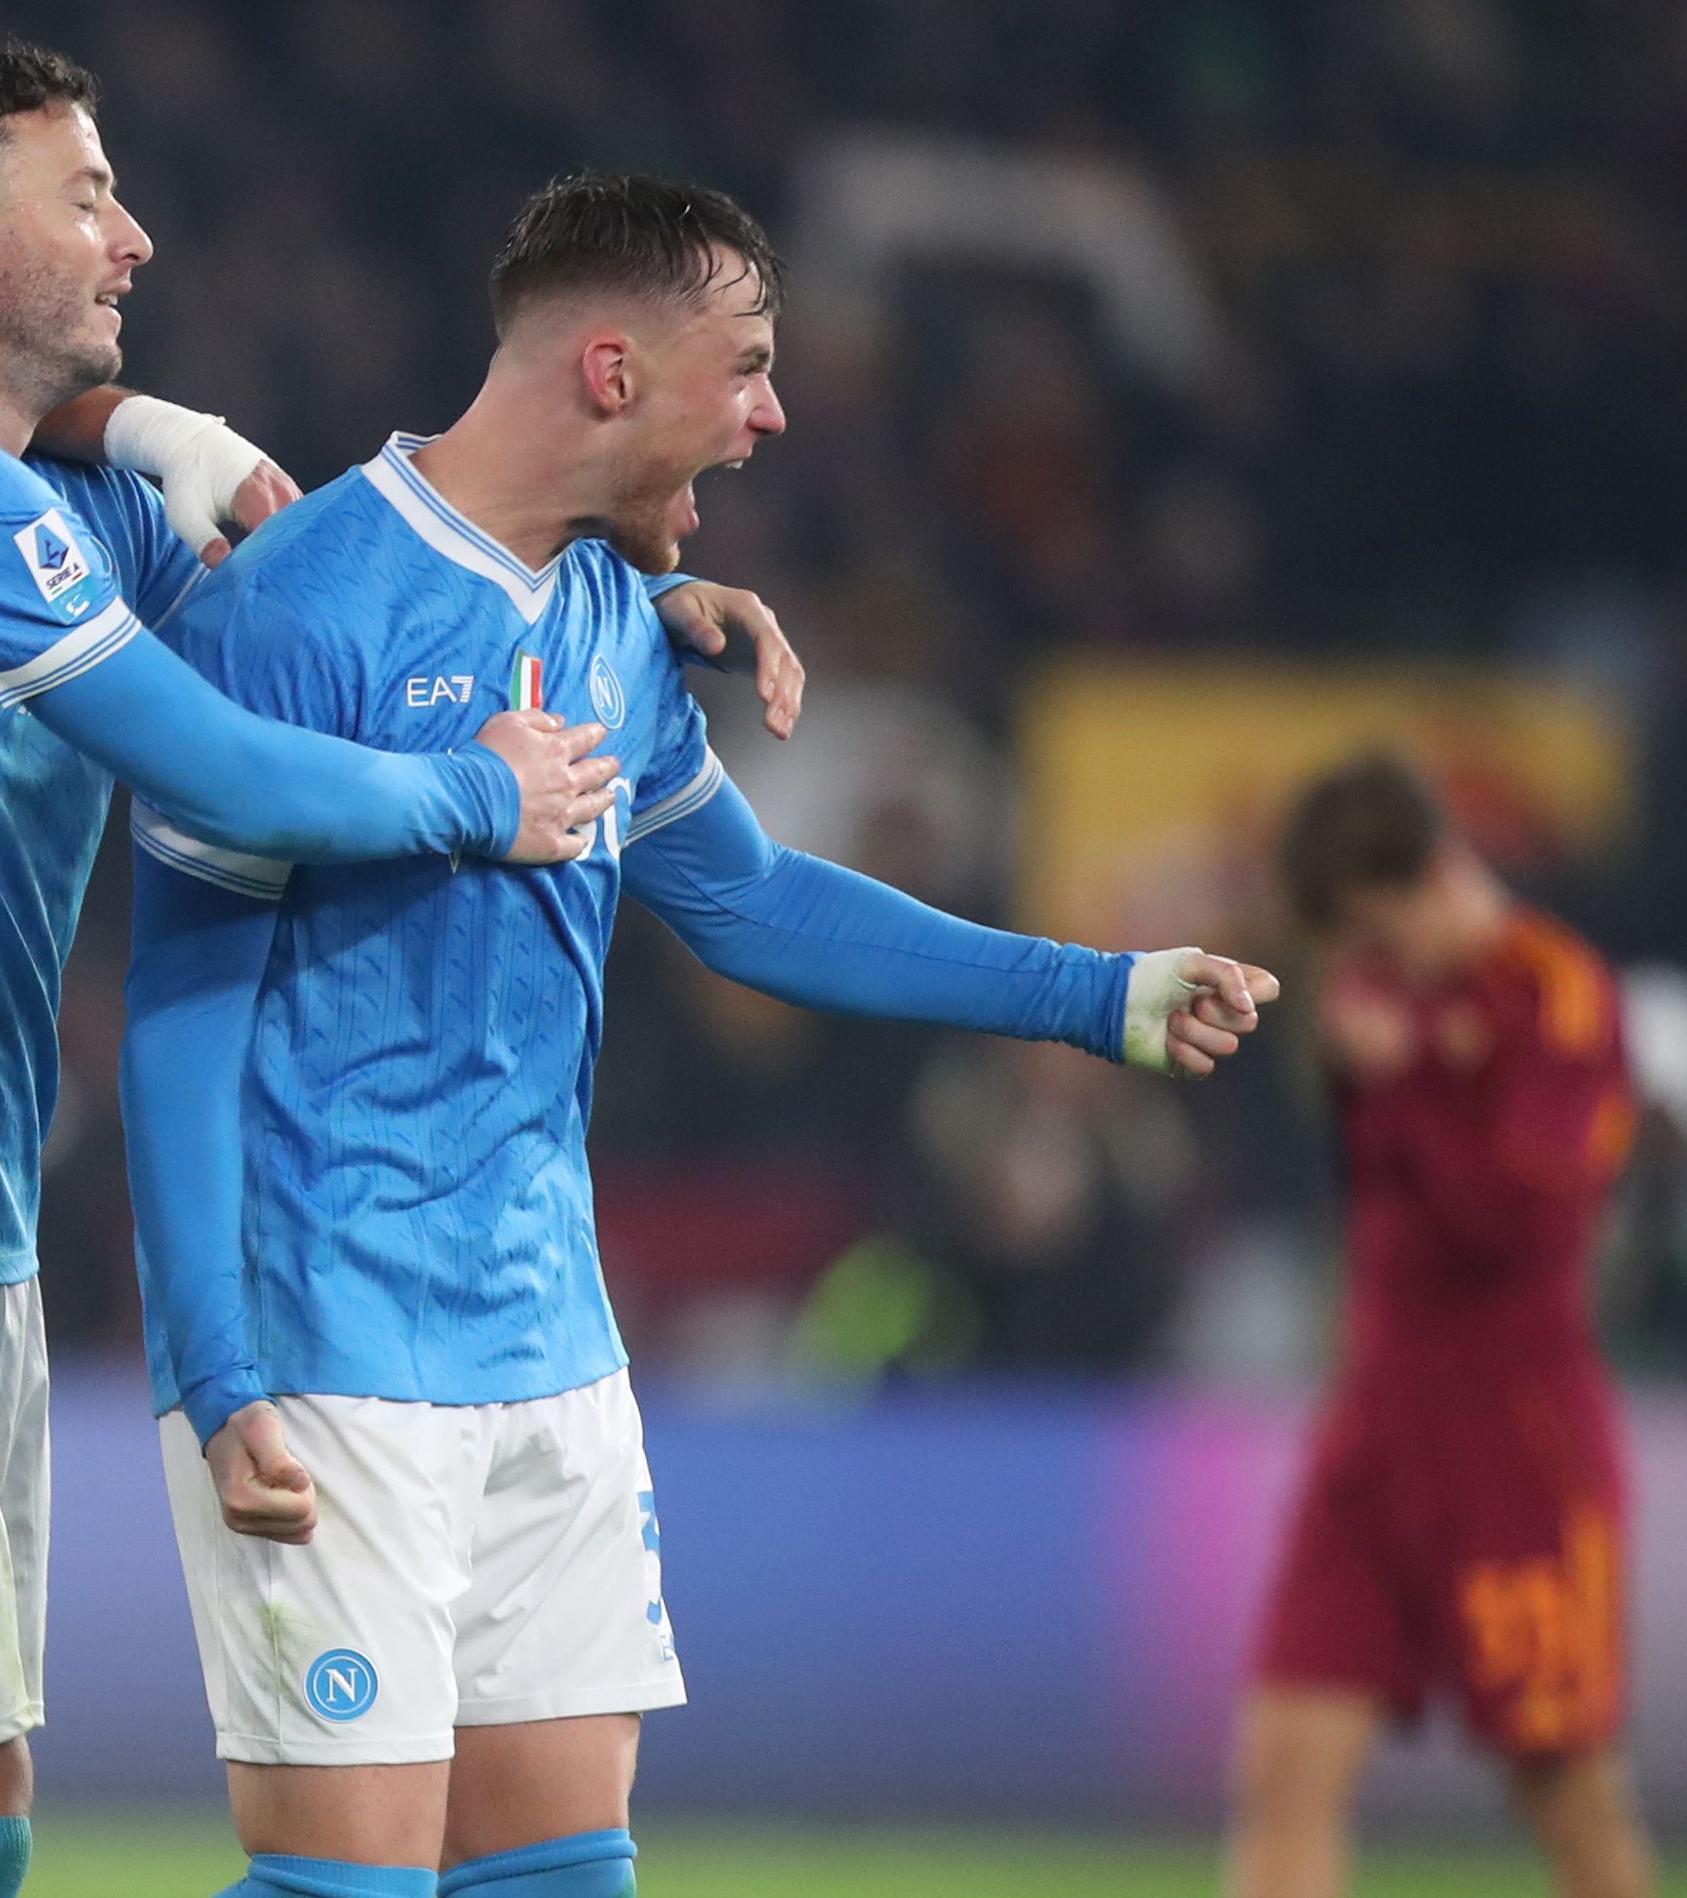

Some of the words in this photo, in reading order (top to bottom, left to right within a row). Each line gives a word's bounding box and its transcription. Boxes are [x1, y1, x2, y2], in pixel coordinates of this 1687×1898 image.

[406, 674, 475, 708] EA7
[595, 675, 613, 709] N
[324, 1667, 359, 1703] N
